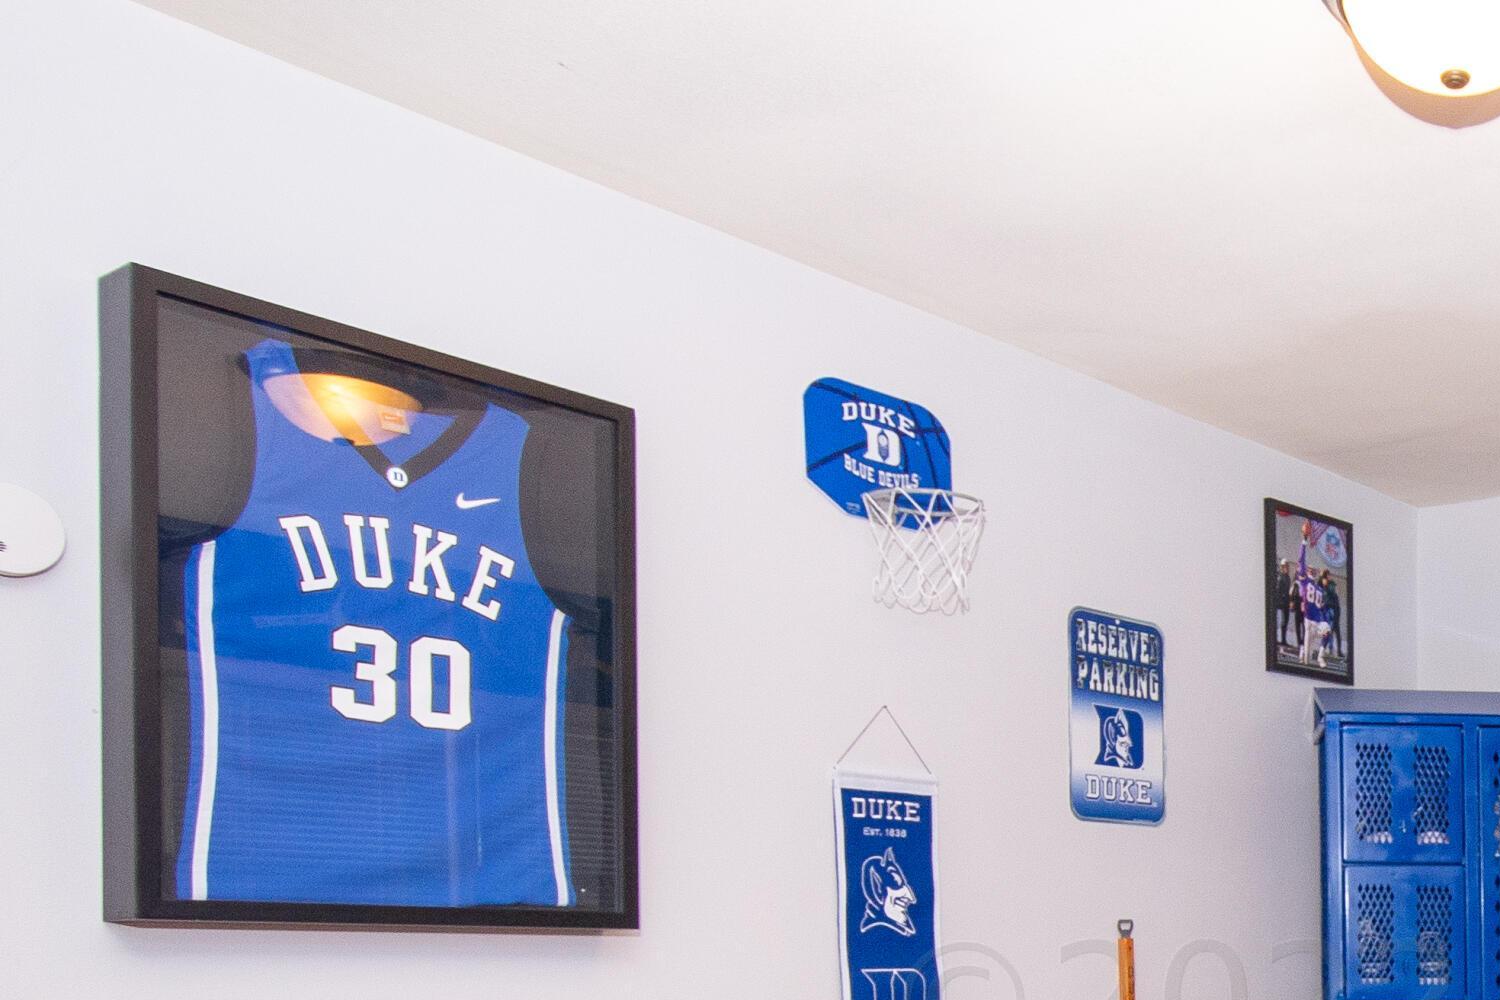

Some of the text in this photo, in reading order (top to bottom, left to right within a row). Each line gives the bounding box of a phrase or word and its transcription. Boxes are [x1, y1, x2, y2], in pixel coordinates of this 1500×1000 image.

[841, 401, 916, 439] DUKE
[843, 451, 920, 489] BLUE DEVILS
[279, 511, 515, 621] DUKE
[1306, 584, 1325, 609] 80
[1075, 617, 1160, 667] RESERVED
[330, 624, 472, 731] 30
[1076, 655, 1160, 702] PARKING
[1085, 773, 1153, 805] DUKE
[851, 797, 921, 822] DUKE
